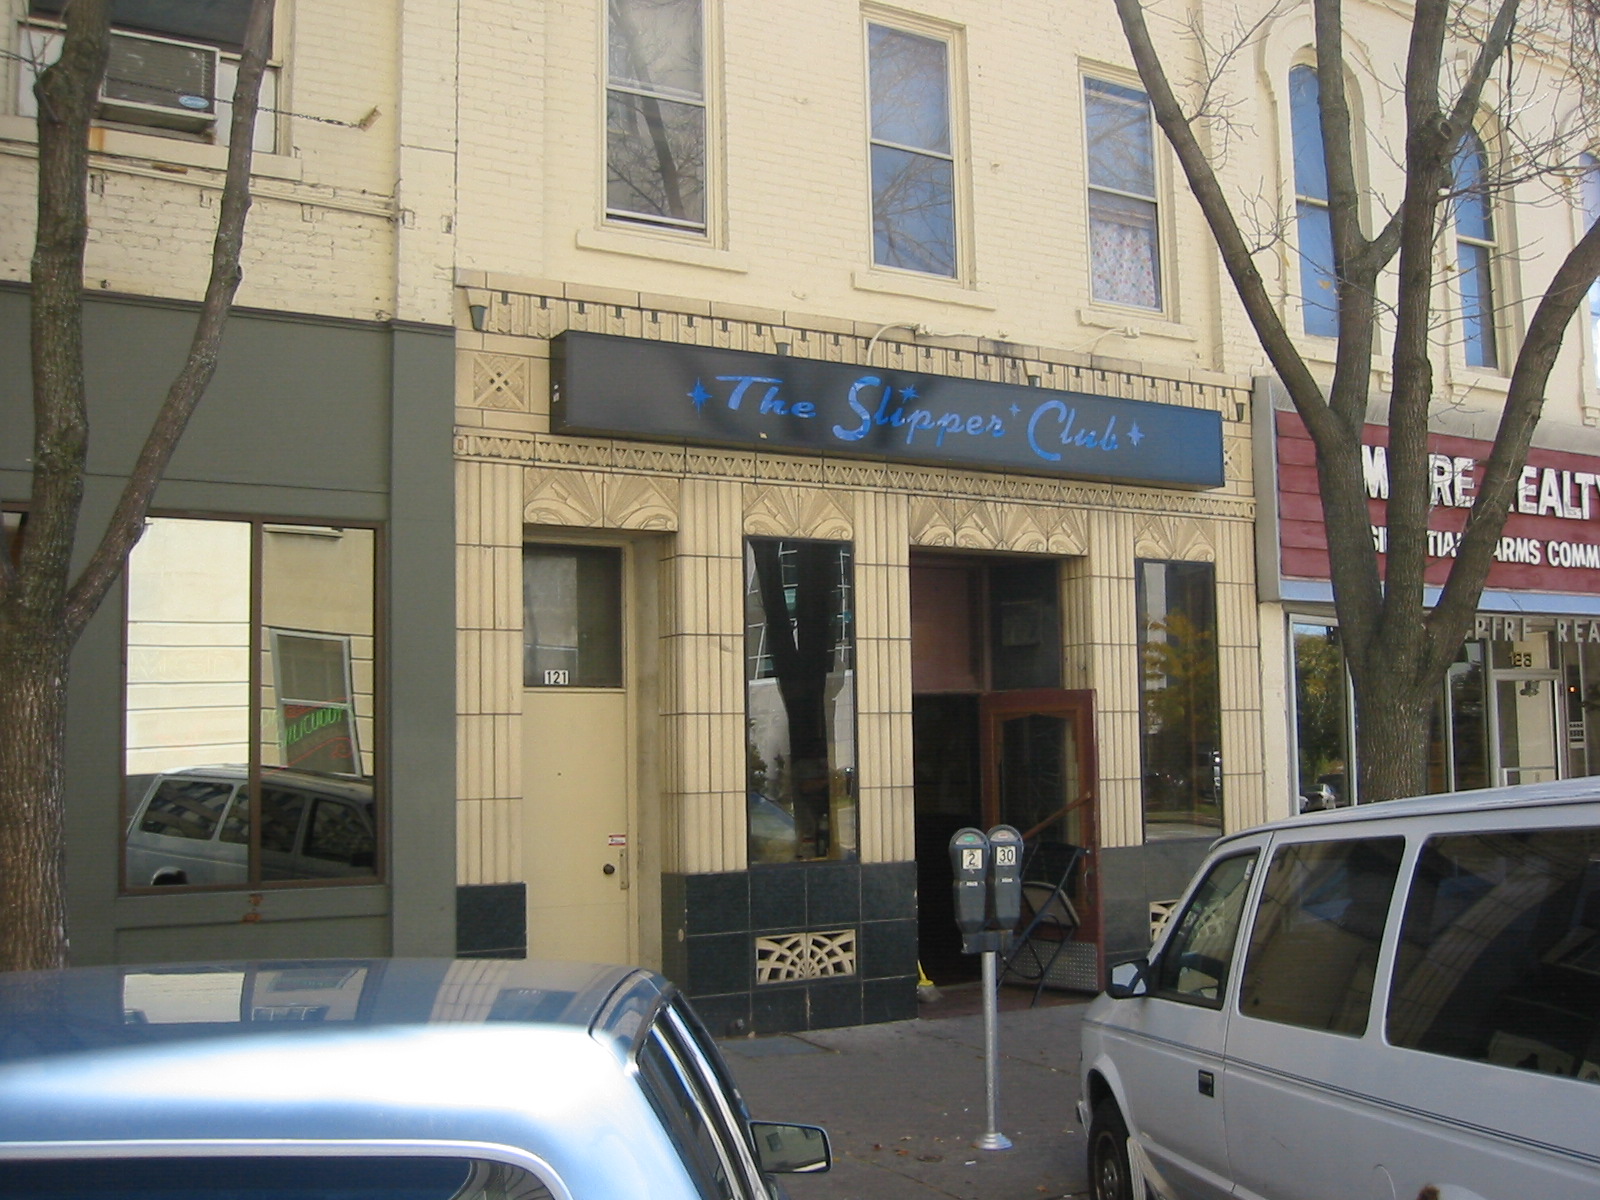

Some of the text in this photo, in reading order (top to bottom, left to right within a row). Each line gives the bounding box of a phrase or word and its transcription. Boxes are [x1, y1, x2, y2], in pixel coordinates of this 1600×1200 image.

[715, 375, 1119, 461] The Slipper Club
[1361, 444, 1600, 520] MRE EALT
[1493, 536, 1541, 565] ARMS
[546, 670, 567, 684] 121
[999, 849, 1013, 861] 30
